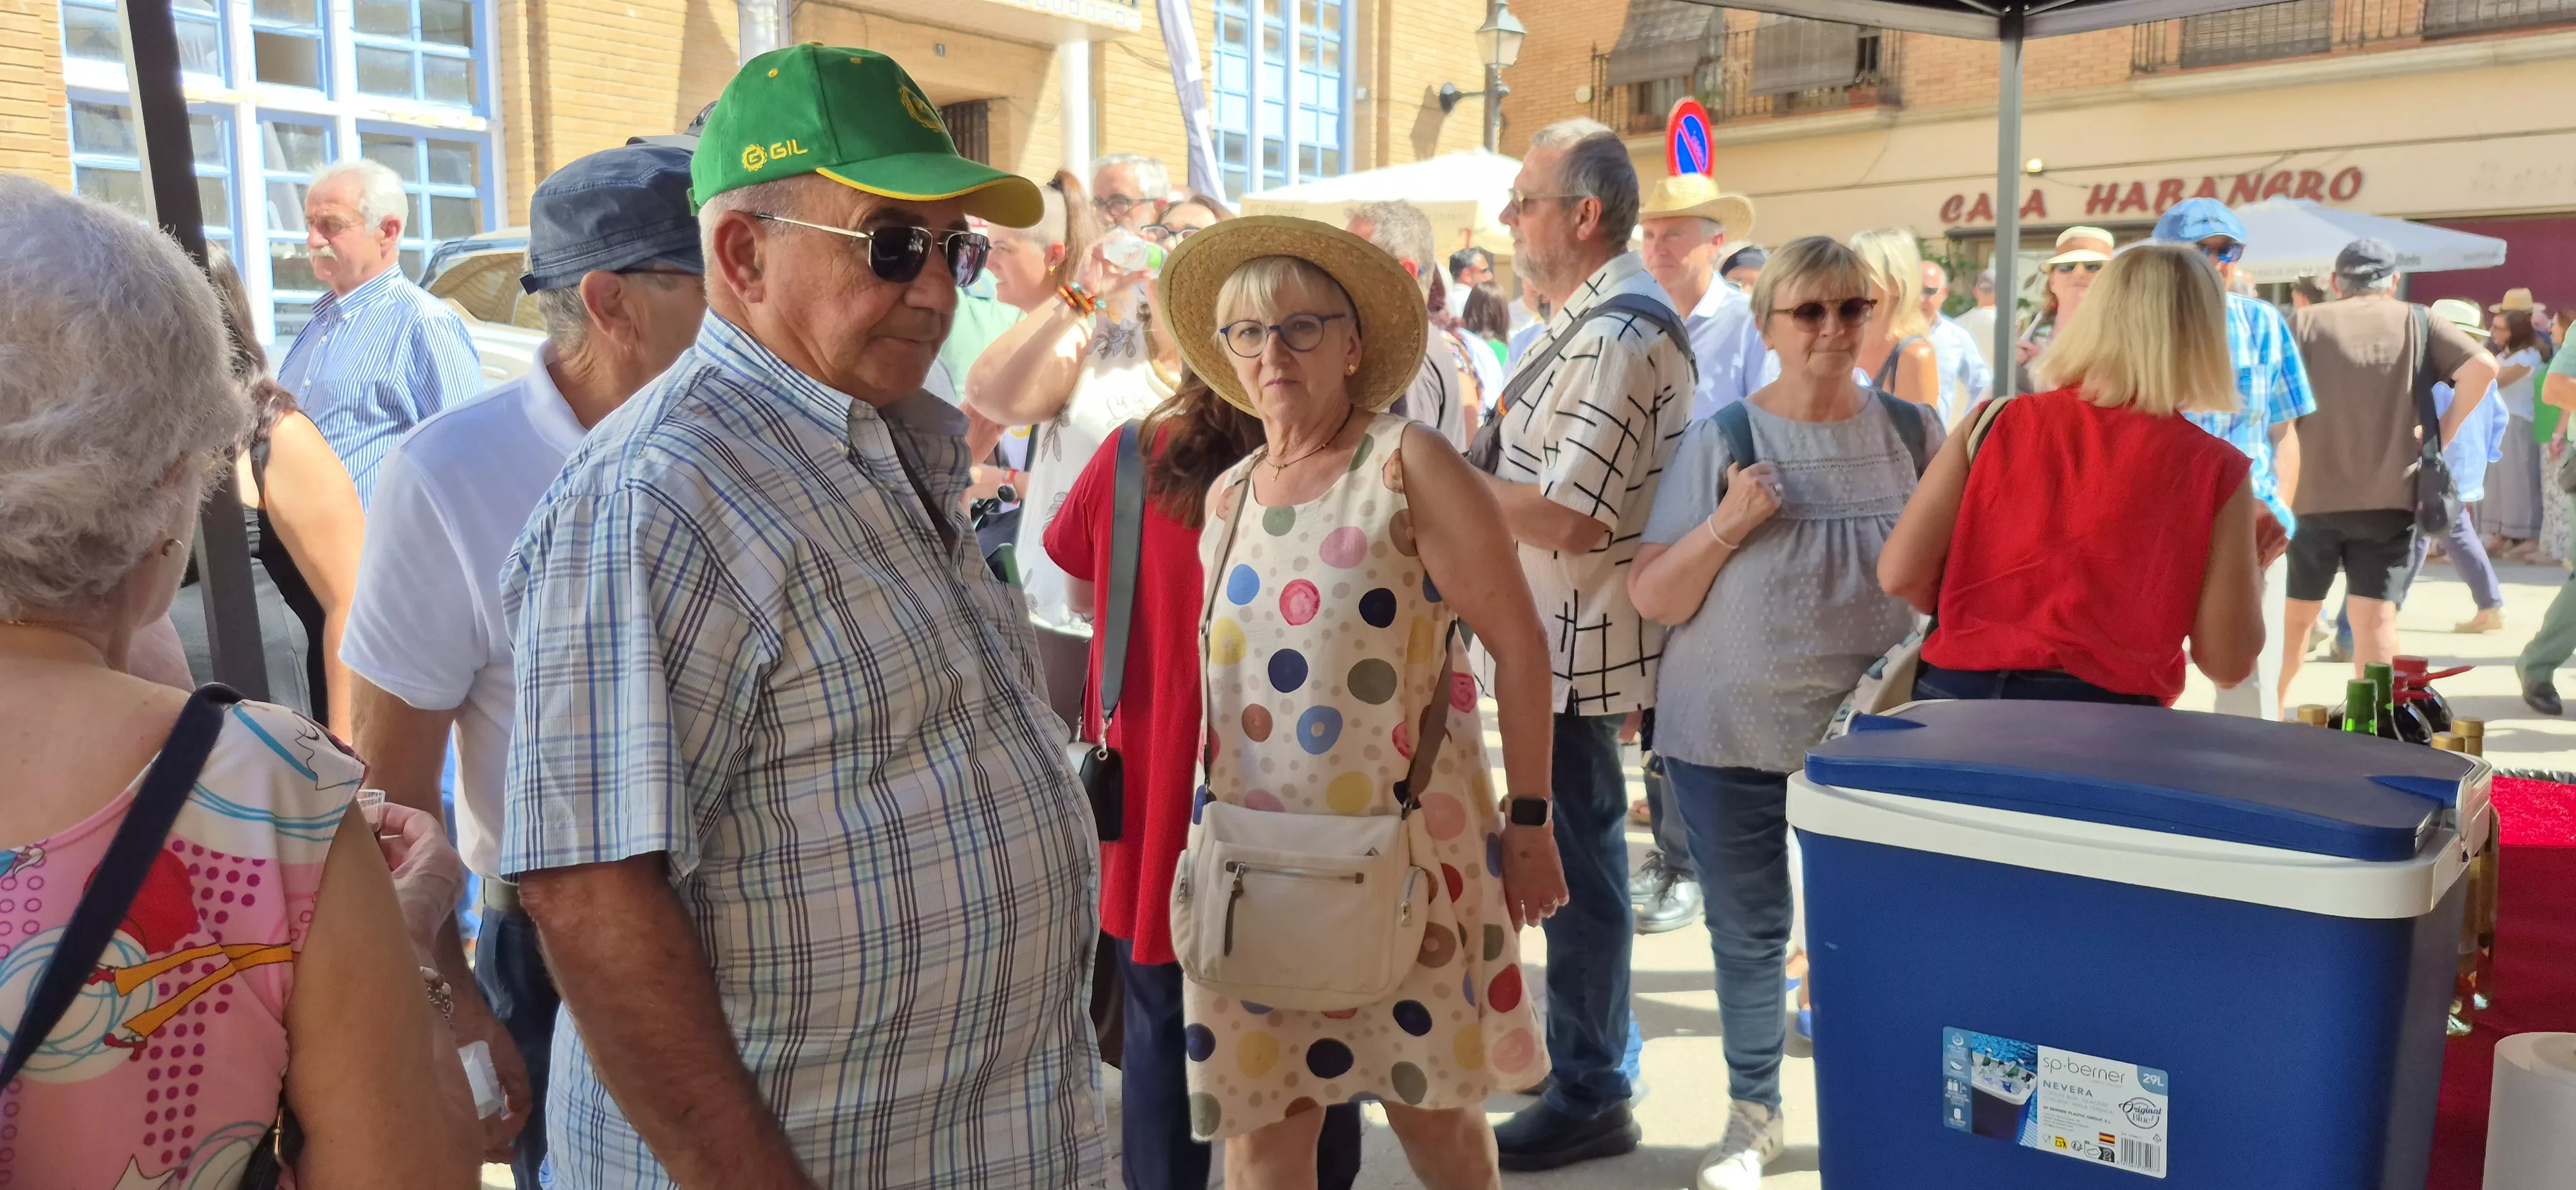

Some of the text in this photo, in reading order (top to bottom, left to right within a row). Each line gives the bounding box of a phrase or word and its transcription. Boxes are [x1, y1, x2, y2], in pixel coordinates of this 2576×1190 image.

[770, 139, 809, 160] GIL
[1940, 166, 2363, 223] CAA HABANERO
[2043, 1079, 2093, 1097] NEVERA
[2143, 1073, 2164, 1087] 29L
[2119, 1100, 2161, 1115] Original
